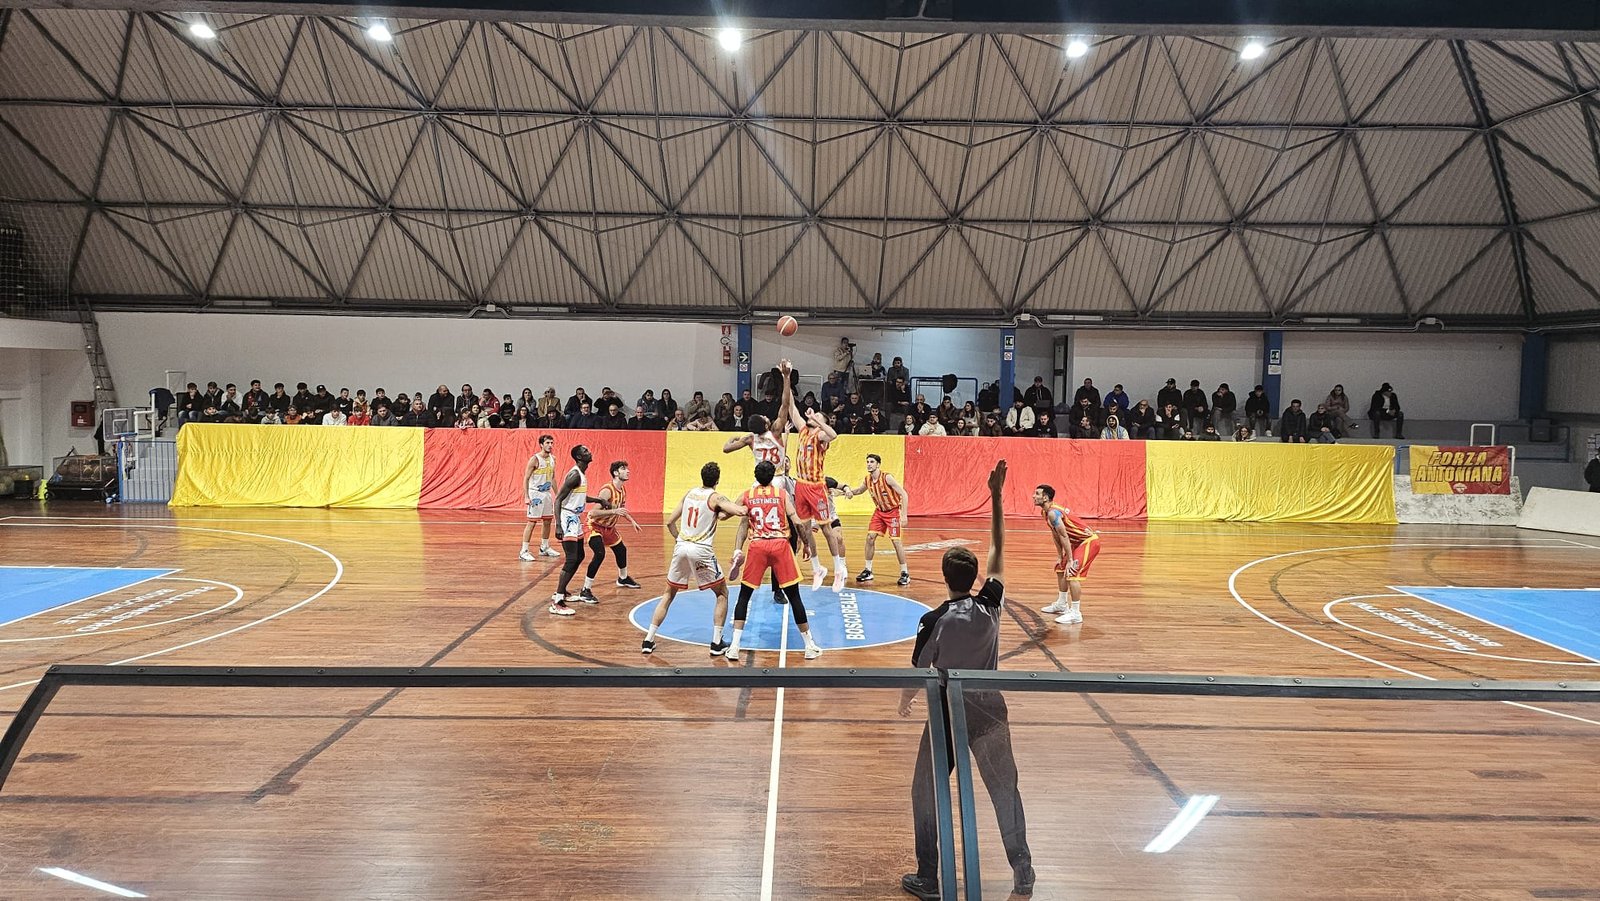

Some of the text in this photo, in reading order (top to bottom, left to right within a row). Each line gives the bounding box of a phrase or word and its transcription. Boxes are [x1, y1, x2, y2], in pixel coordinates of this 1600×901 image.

[1428, 450, 1488, 466] FORZA
[1415, 465, 1502, 482] ANTONIANA
[687, 506, 700, 529] 11
[751, 506, 781, 530] 34
[838, 592, 866, 640] BOSCOREALE
[1392, 607, 1503, 647] BOSCOREALE
